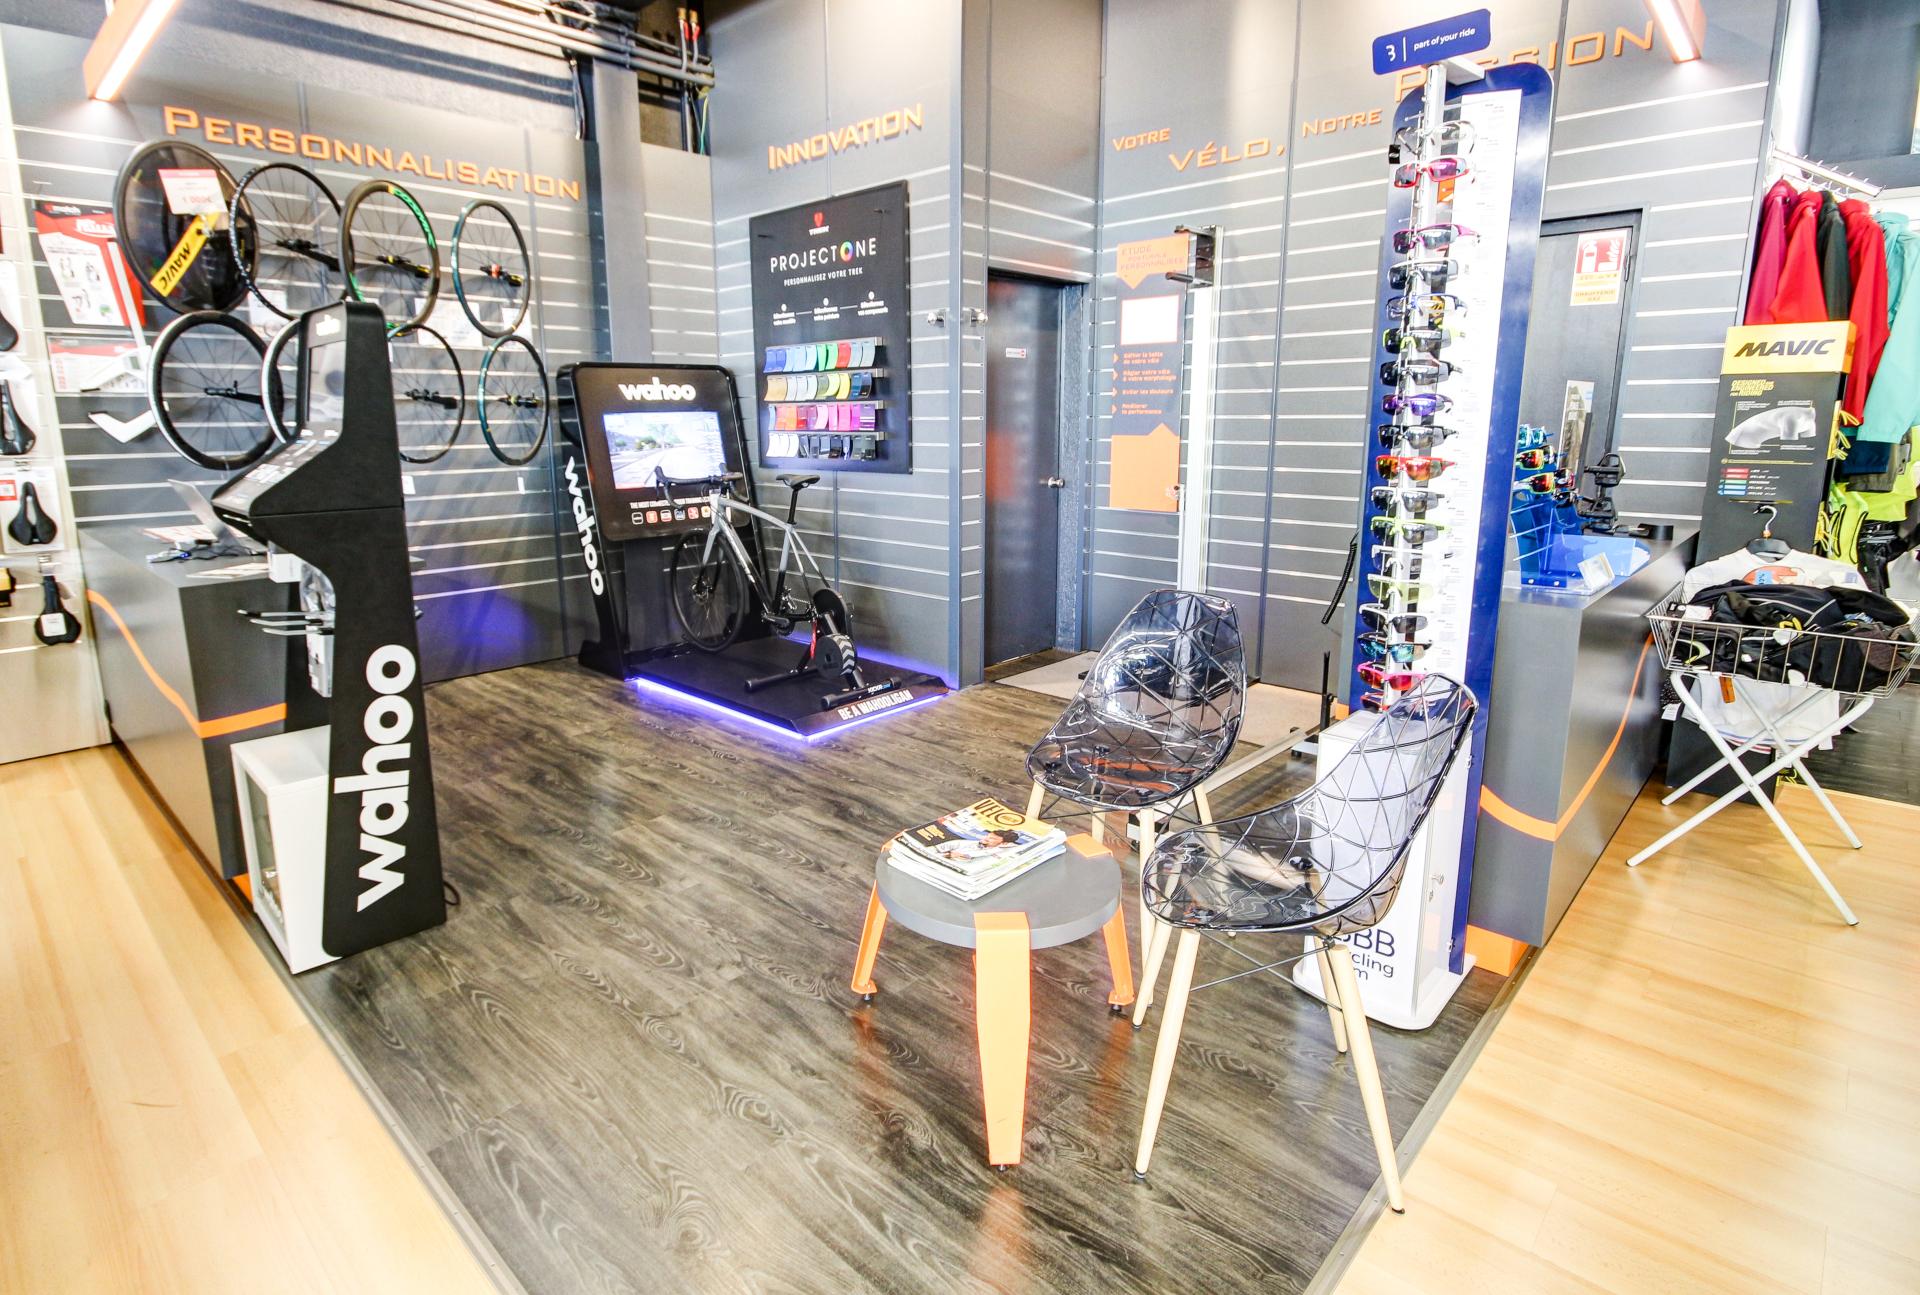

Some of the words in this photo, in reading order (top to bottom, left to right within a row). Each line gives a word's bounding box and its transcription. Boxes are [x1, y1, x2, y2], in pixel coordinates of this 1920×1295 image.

[1413, 39, 1430, 51] part
[1431, 36, 1440, 46] of
[1440, 33, 1458, 46] your
[1459, 27, 1476, 39] ride
[163, 105, 581, 201] PERSONNALISATION
[768, 102, 924, 171] INNOVATION
[1111, 127, 1171, 151] VOTRE
[1168, 137, 1287, 172] VÉLO,
[1302, 108, 1383, 138] NOTRE
[159, 242, 191, 290] MAVIC
[784, 272, 826, 287] PERSONNALISEZ
[828, 269, 847, 279] VOTRE
[848, 267, 863, 276] TREK
[1734, 338, 1836, 357] MAVIC
[618, 376, 697, 401] wahoo
[565, 456, 604, 596] wahoo
[838, 707, 853, 720] BE
[851, 706, 860, 717] A
[860, 690, 914, 715] WAHOOLIGAN
[333, 644, 416, 912] wahoo
[1351, 951, 1394, 979] cling
